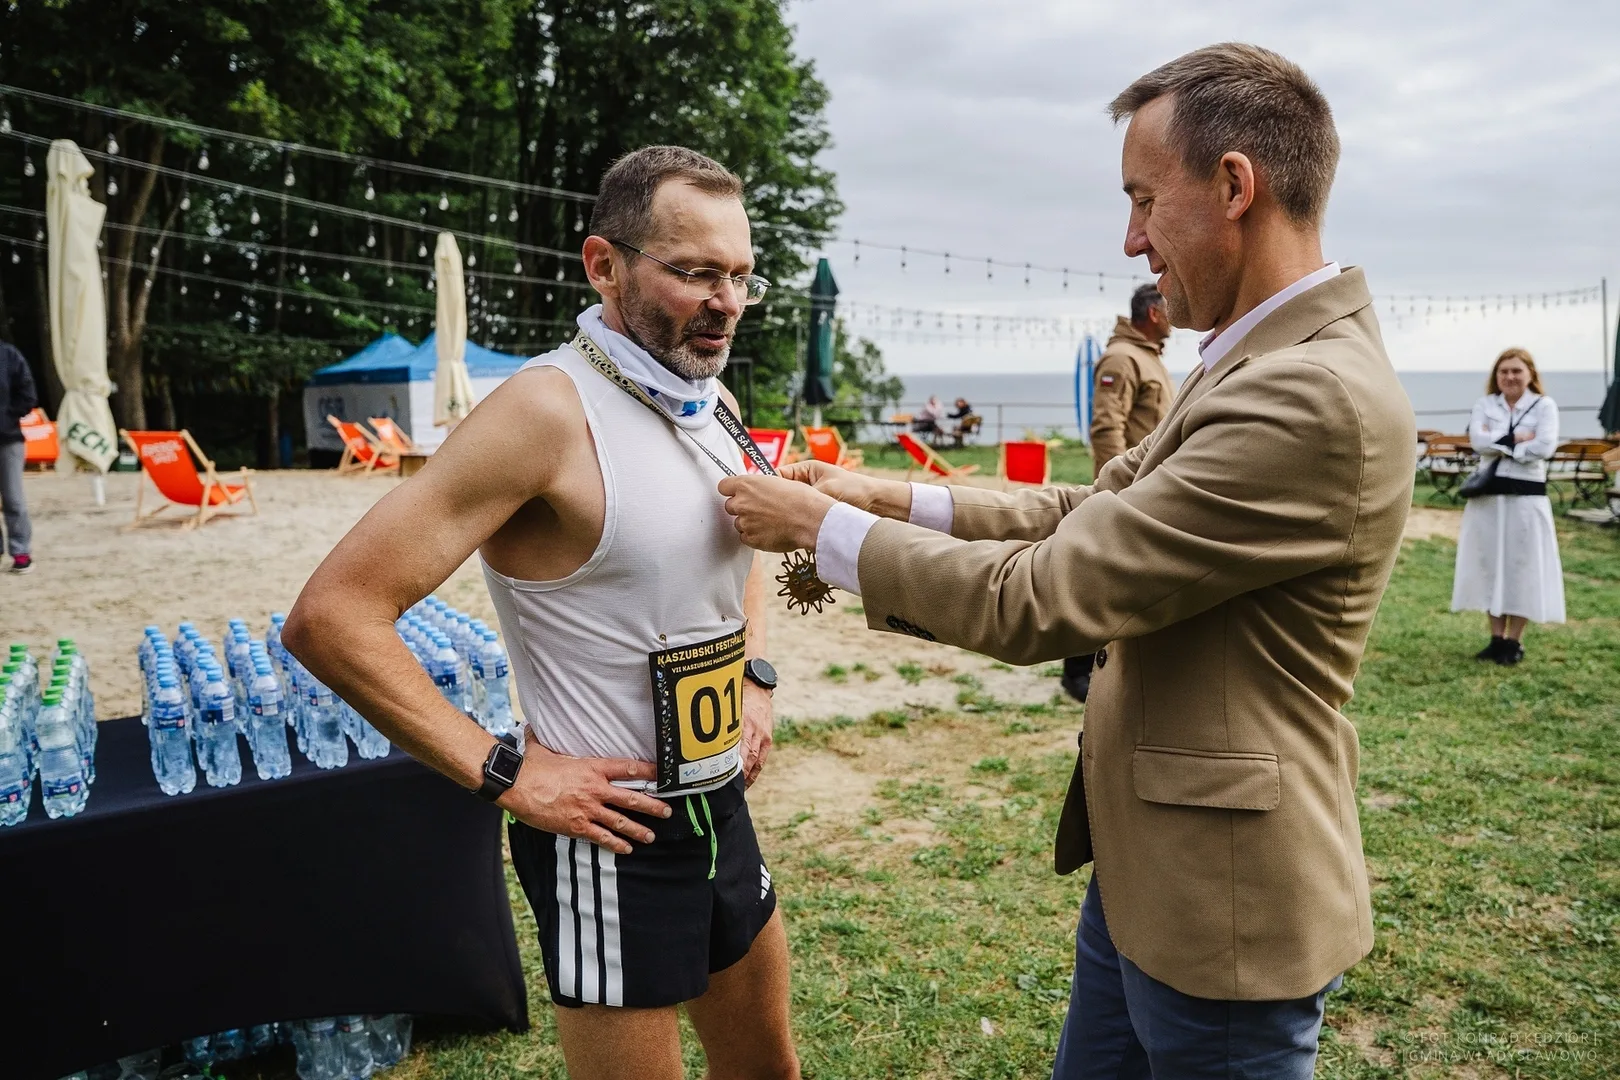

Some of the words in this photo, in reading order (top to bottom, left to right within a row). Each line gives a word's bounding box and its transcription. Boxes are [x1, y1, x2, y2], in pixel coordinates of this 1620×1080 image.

[657, 645, 714, 665] KASZUBSKI
[671, 666, 681, 674] VII
[683, 660, 713, 671] KASZUBSKI
[690, 677, 739, 743] 01
